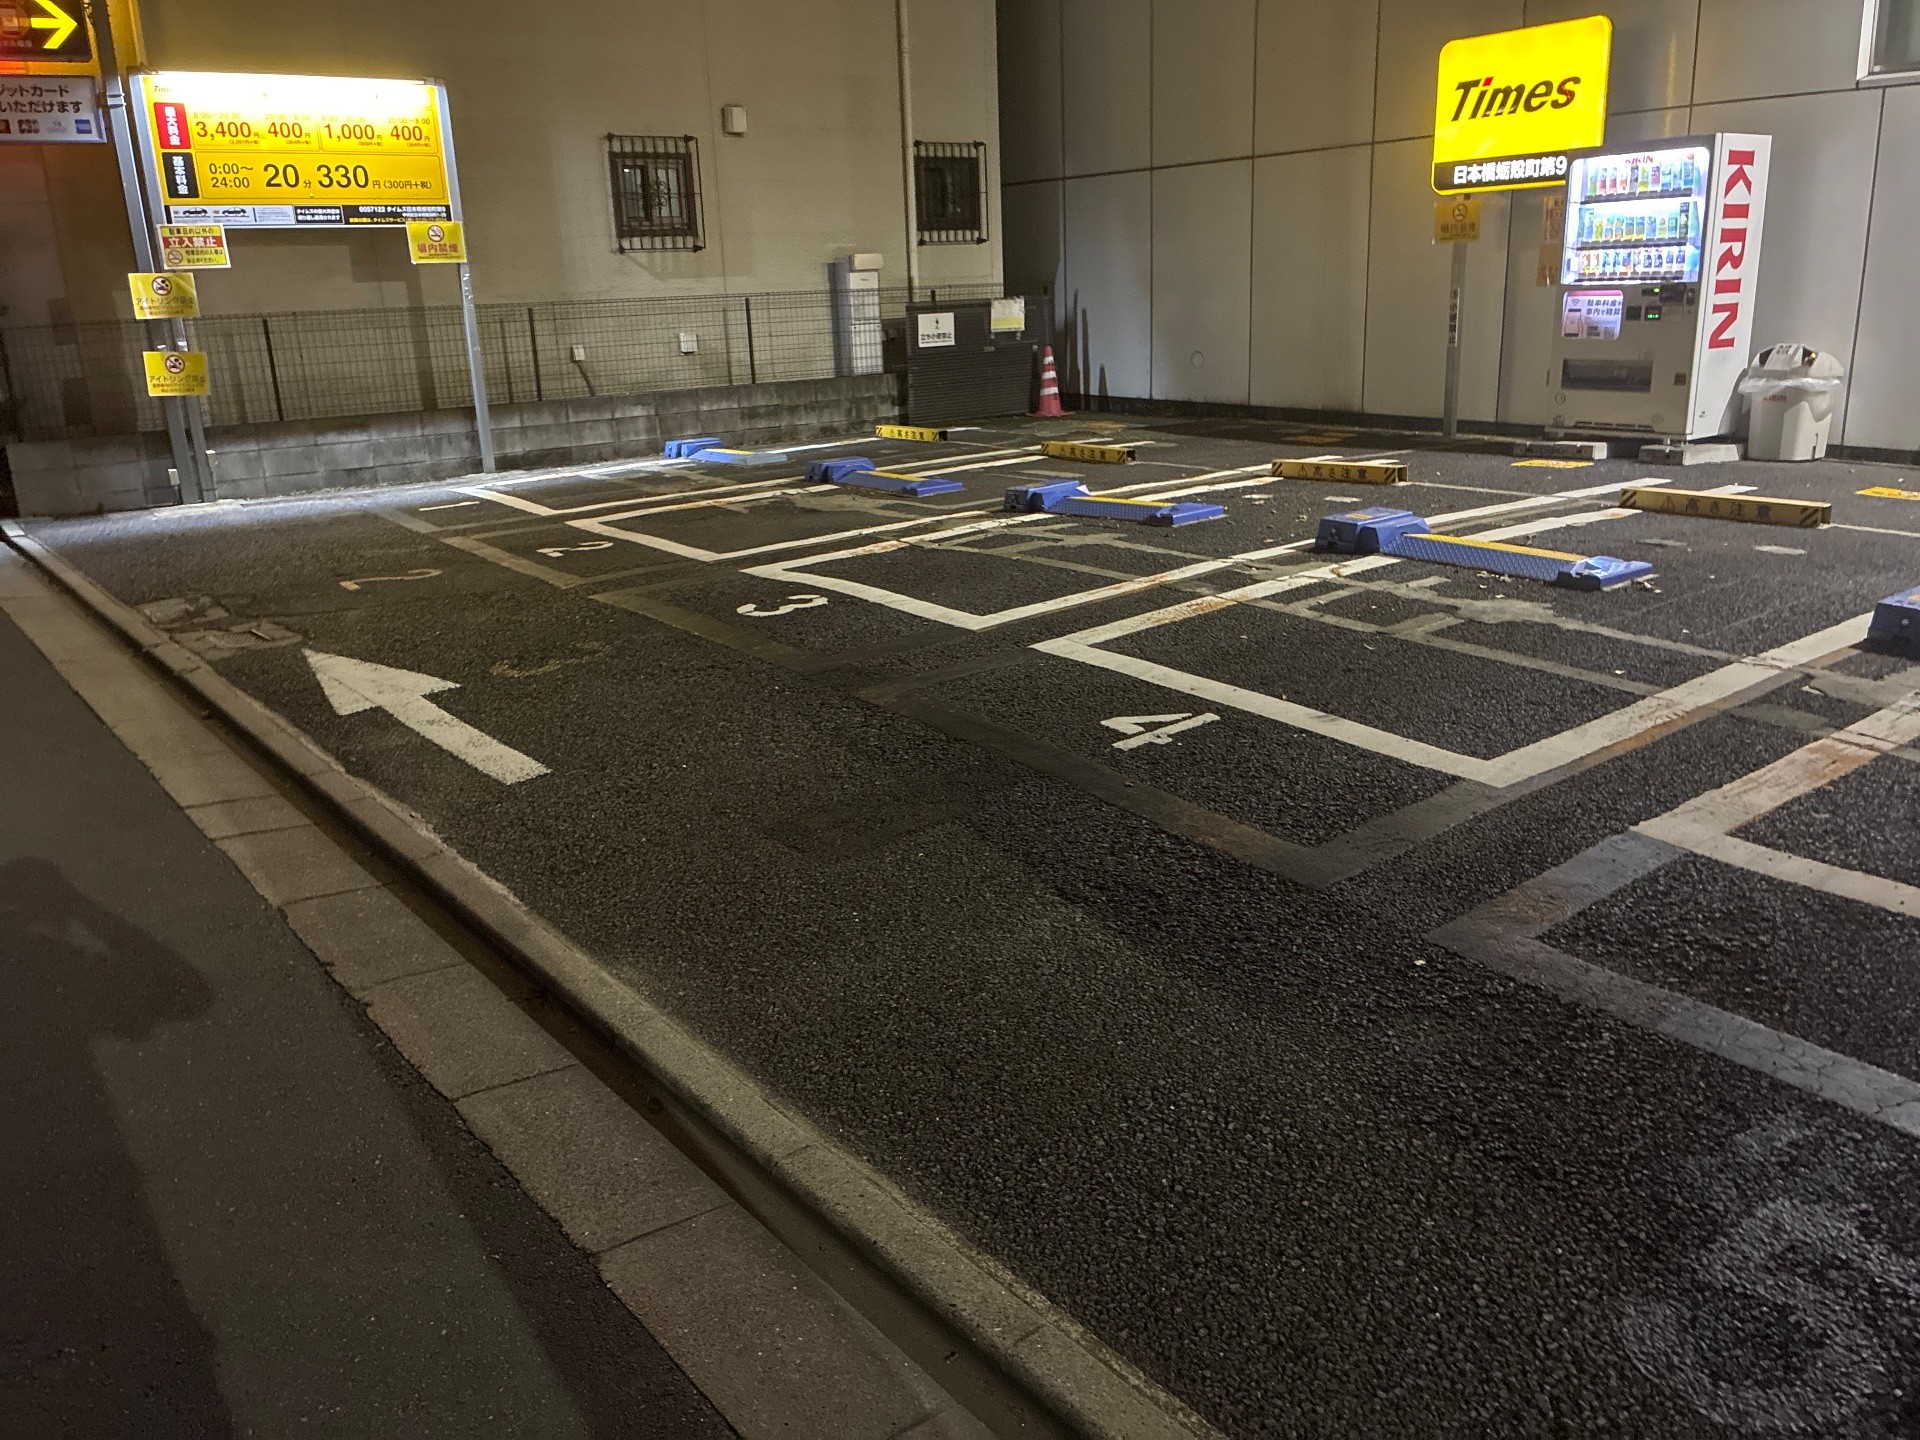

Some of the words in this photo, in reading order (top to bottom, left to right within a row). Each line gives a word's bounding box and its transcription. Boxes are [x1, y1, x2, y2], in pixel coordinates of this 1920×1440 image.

[1450, 76, 1582, 122] Times
[211, 176, 250, 188] 24:00
[1708, 149, 1756, 350] KIRIN
[1312, 465, 1368, 480] 高さ注意
[1685, 497, 1772, 520] 高さ注意
[535, 541, 614, 558] 2
[735, 593, 829, 618] 3
[1099, 712, 1222, 752] 4
